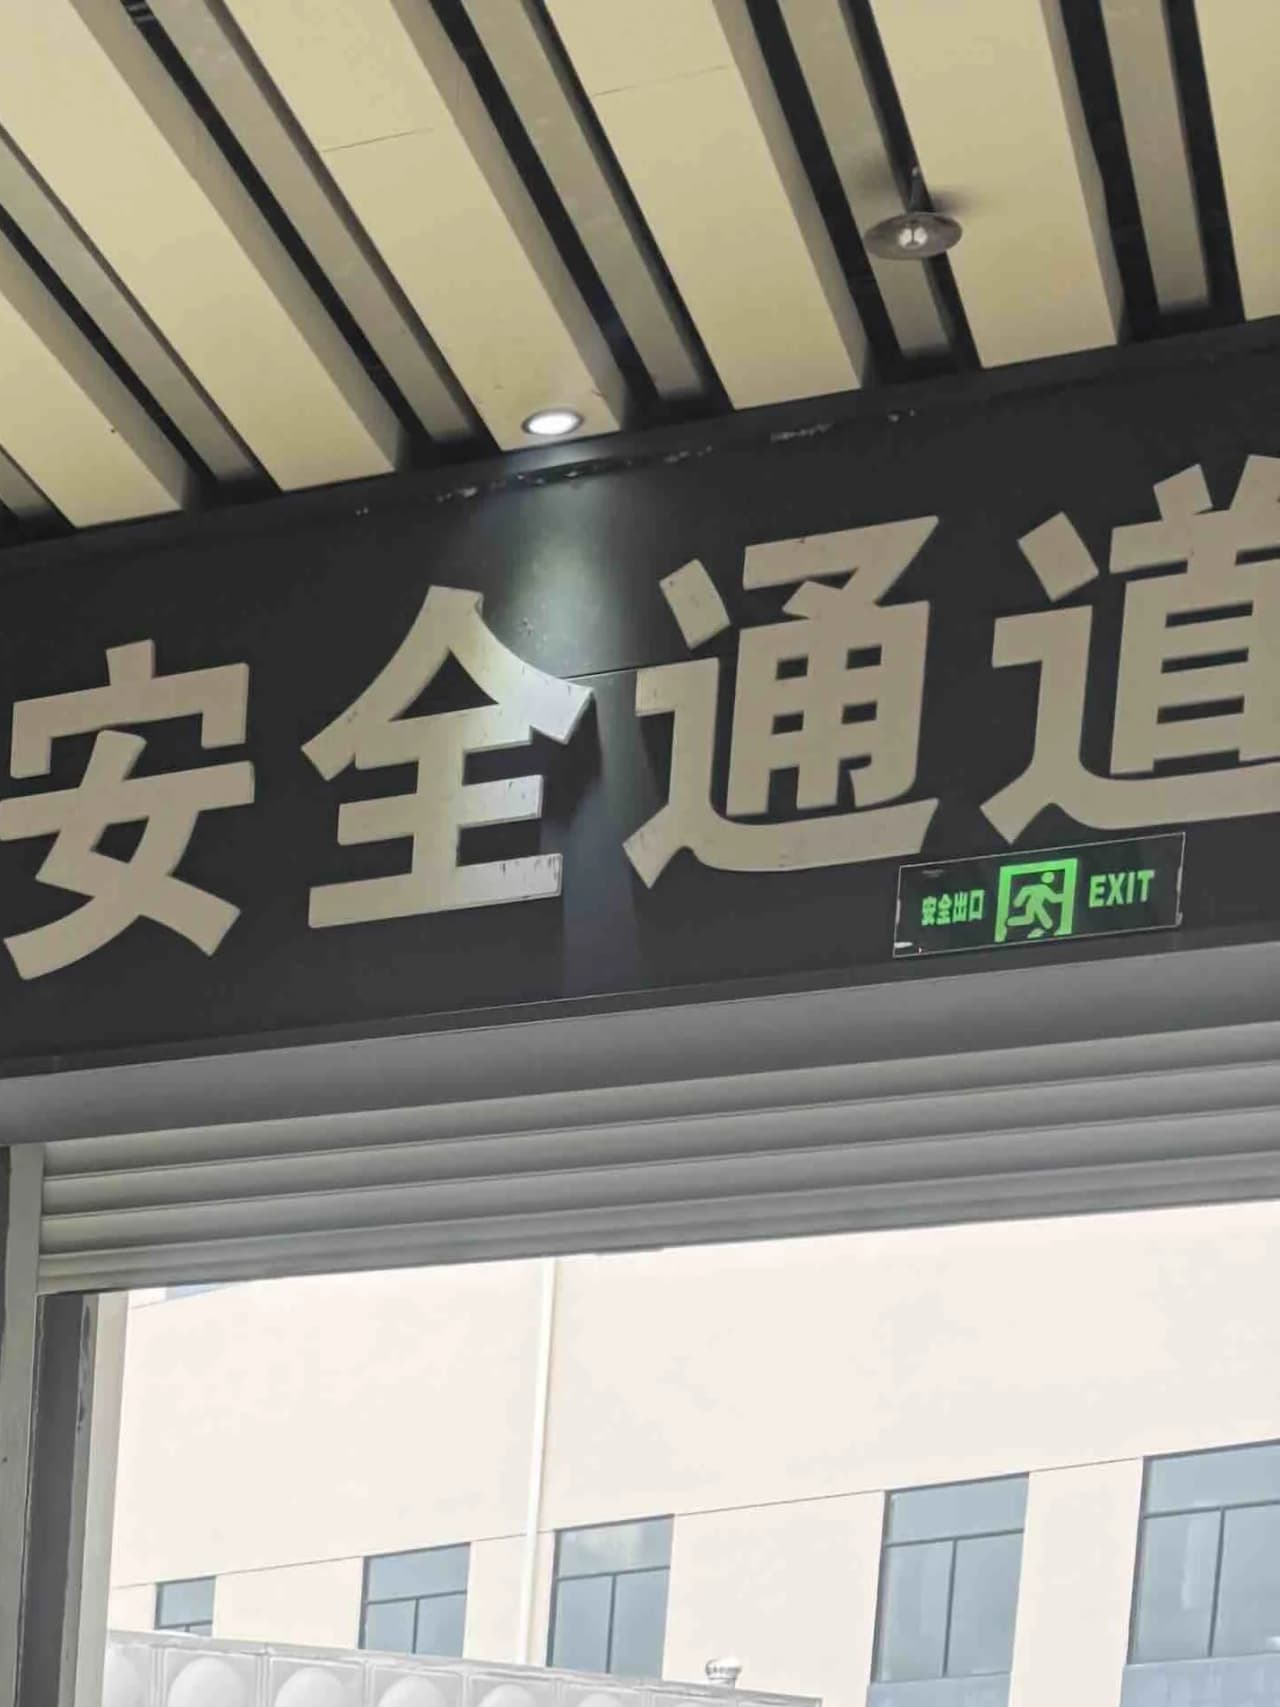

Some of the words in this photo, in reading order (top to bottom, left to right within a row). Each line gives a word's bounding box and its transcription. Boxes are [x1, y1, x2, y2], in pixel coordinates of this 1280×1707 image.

[920, 888, 985, 926] 安全出口
[1088, 869, 1156, 909] EXIT
